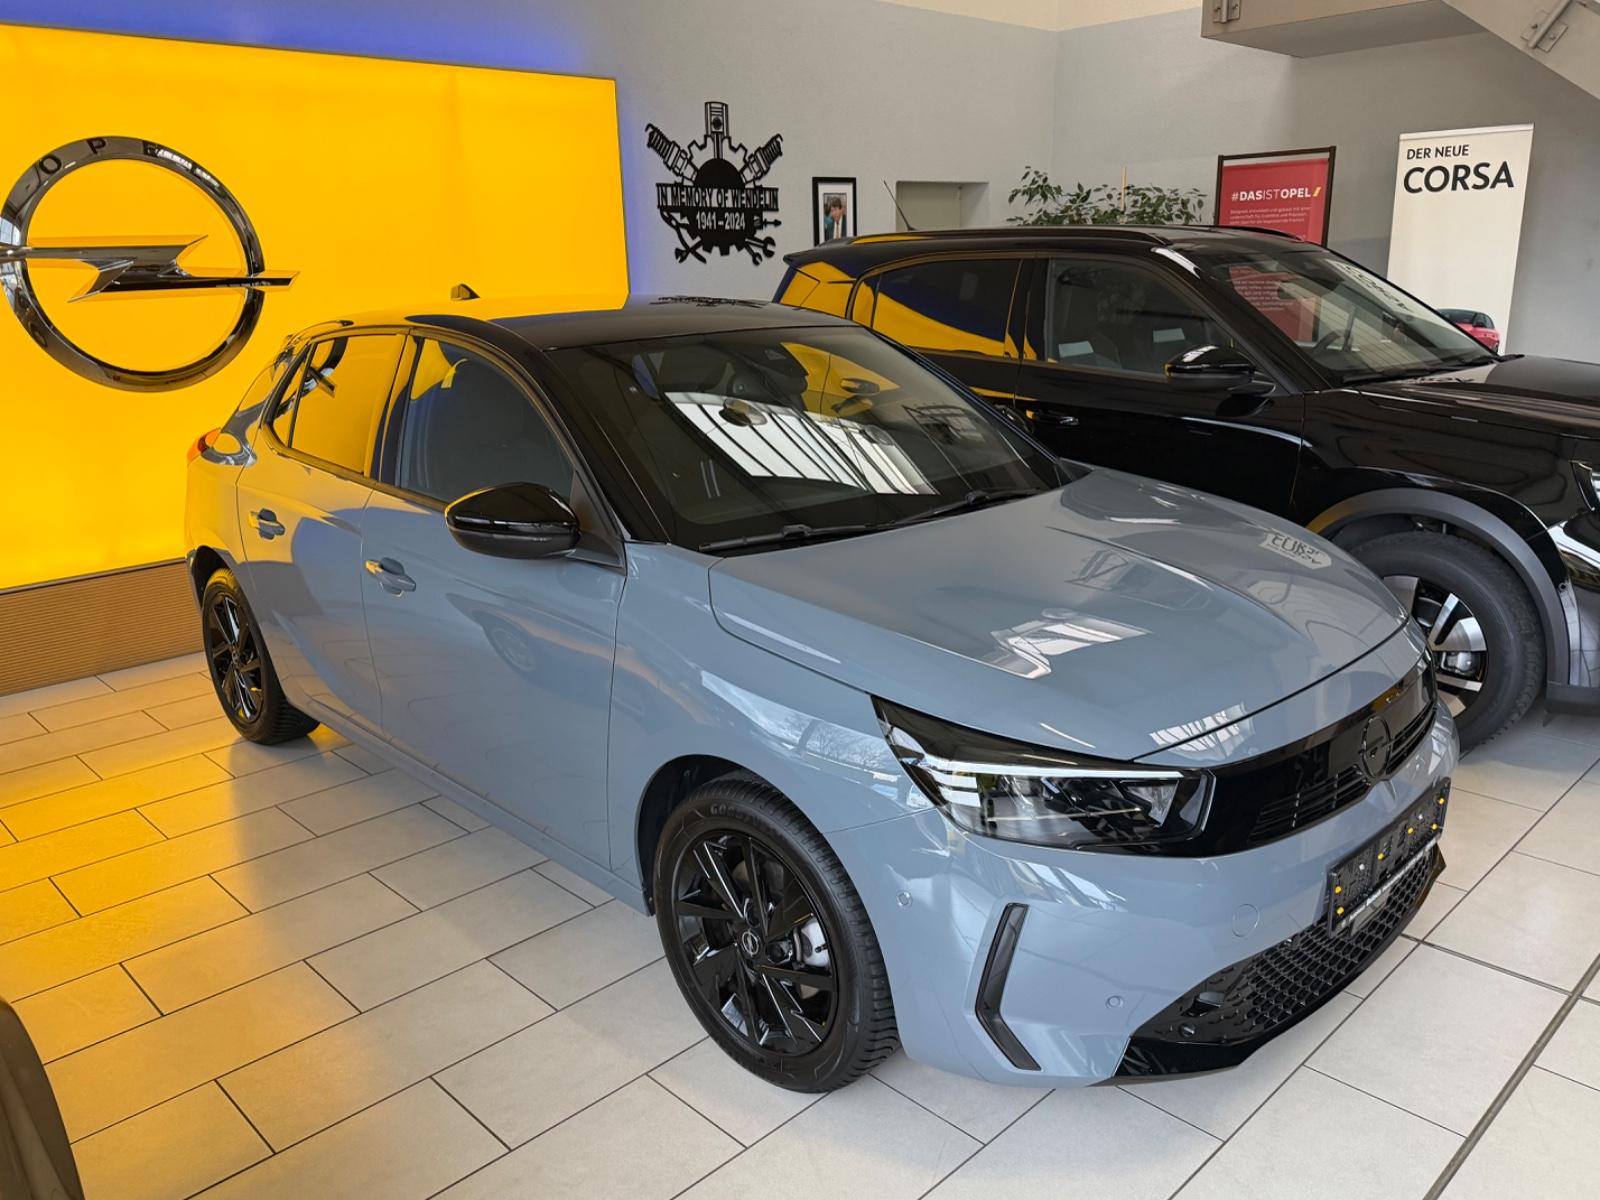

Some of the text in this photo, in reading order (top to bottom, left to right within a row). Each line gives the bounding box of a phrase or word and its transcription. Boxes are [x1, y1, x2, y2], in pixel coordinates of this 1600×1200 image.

[1406, 144, 1470, 160] DER NEUE
[1403, 161, 1515, 194] CORSA
[656, 184, 779, 210] IN MEMORY OF WENDELIN
